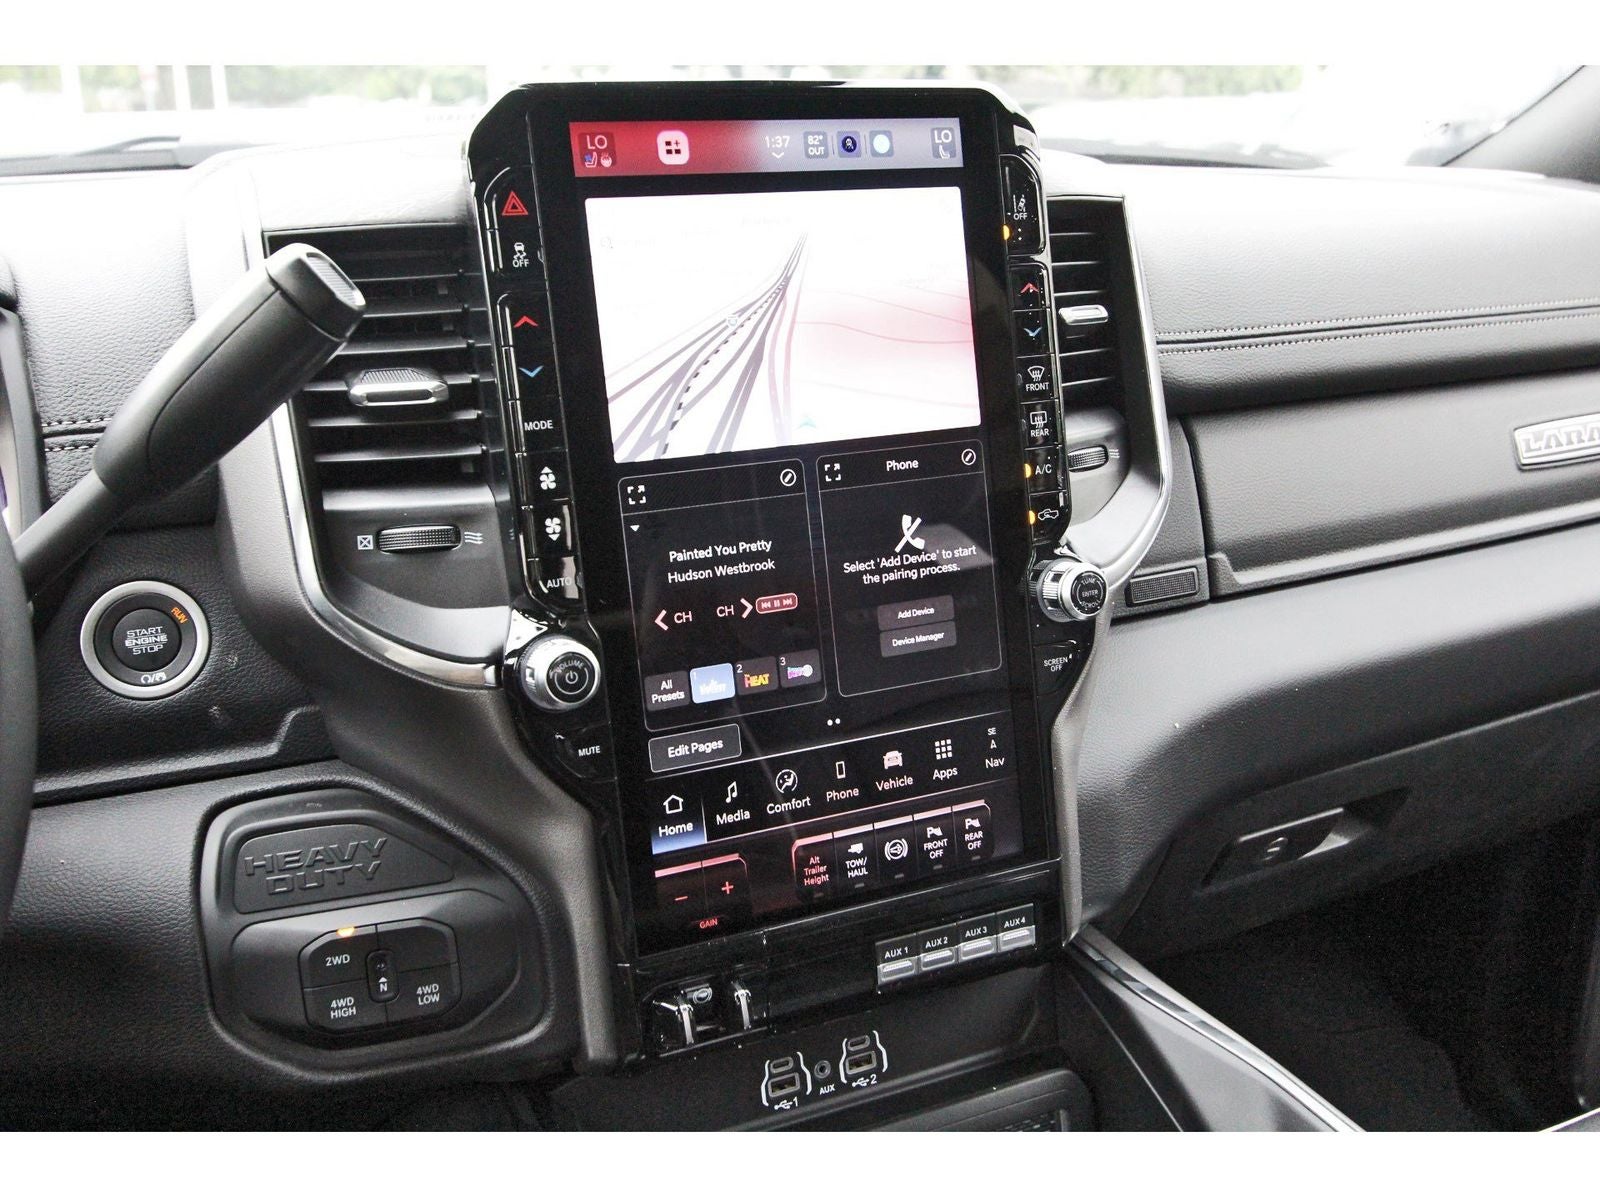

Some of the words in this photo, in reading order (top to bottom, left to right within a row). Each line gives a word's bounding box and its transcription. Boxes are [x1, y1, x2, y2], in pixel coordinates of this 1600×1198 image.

[586, 134, 608, 150] LO
[765, 135, 790, 149] 1:37
[934, 129, 952, 144] LO
[808, 146, 825, 156] OUT
[1013, 212, 1028, 221] OFF
[512, 258, 530, 268] OFF
[1025, 382, 1050, 392] FRONT
[523, 419, 554, 431] MODE
[1030, 428, 1050, 438] REAR
[885, 459, 919, 472] Phone
[1035, 464, 1052, 476] A/C
[669, 546, 713, 563] Painted
[714, 543, 737, 557] You
[738, 539, 773, 554] Pretty
[843, 559, 876, 574] Select
[941, 549, 953, 560] to
[953, 544, 977, 558] start
[667, 568, 713, 584] Hudson
[714, 558, 776, 577] Westbrook
[862, 573, 880, 585] the
[882, 568, 918, 584] pairing
[919, 563, 961, 578] process.
[546, 576, 572, 588] AUTO
[171, 607, 188, 624] RUN
[673, 610, 693, 624] CH
[716, 604, 735, 618] CH
[897, 611, 912, 619] Add
[912, 606, 935, 617] Device
[126, 626, 163, 637] START
[124, 634, 168, 647] ENGINE
[891, 637, 916, 647] Device
[915, 632, 945, 643] Manager
[132, 644, 164, 655] STOP
[556, 659, 585, 674] VOLUME
[779, 656, 786, 666] 3
[1043, 657, 1069, 667] SCREEN
[736, 664, 743, 673] 2
[1050, 664, 1063, 673] OFF
[660, 679, 673, 691] All
[651, 691, 685, 704] Presets
[987, 727, 997, 736] SE
[578, 745, 601, 757] MUTE
[667, 742, 690, 758] Edit
[690, 739, 724, 756] Pages
[985, 757, 1005, 769] Nav
[932, 766, 958, 780] Apps
[875, 775, 914, 792] Vehicle
[826, 786, 859, 802] Phone
[766, 797, 811, 815] Comfort
[716, 809, 750, 826] Media
[658, 822, 694, 838] Home
[964, 831, 983, 842] REAR
[923, 838, 948, 852] FRONT
[967, 841, 982, 851] OFF
[244, 838, 388, 876] HEAVY
[809, 855, 821, 865] Alt
[929, 849, 944, 860] OFF
[845, 856, 868, 870] TOW/
[803, 865, 827, 877] Trailer
[847, 868, 868, 879] HAUL
[804, 874, 829, 887] Height
[699, 918, 719, 930] GAIN
[1003, 919, 1020, 929] AUX
[1020, 916, 1027, 925] 4
[965, 928, 982, 939] AUX
[982, 926, 988, 935] 3
[925, 939, 943, 950] AUX
[943, 936, 949, 945] 2
[884, 949, 903, 960] AUX
[904, 946, 909, 955] 1
[325, 953, 351, 967] 2WD
[379, 982, 388, 993] N
[416, 983, 440, 996] 4WD
[330, 996, 355, 1009] 4WD
[418, 992, 440, 1006] LOW
[330, 1006, 357, 1020] HIGH
[870, 1073, 878, 1085] 2
[819, 1084, 835, 1095] AUX
[792, 1096, 799, 1107] 1
